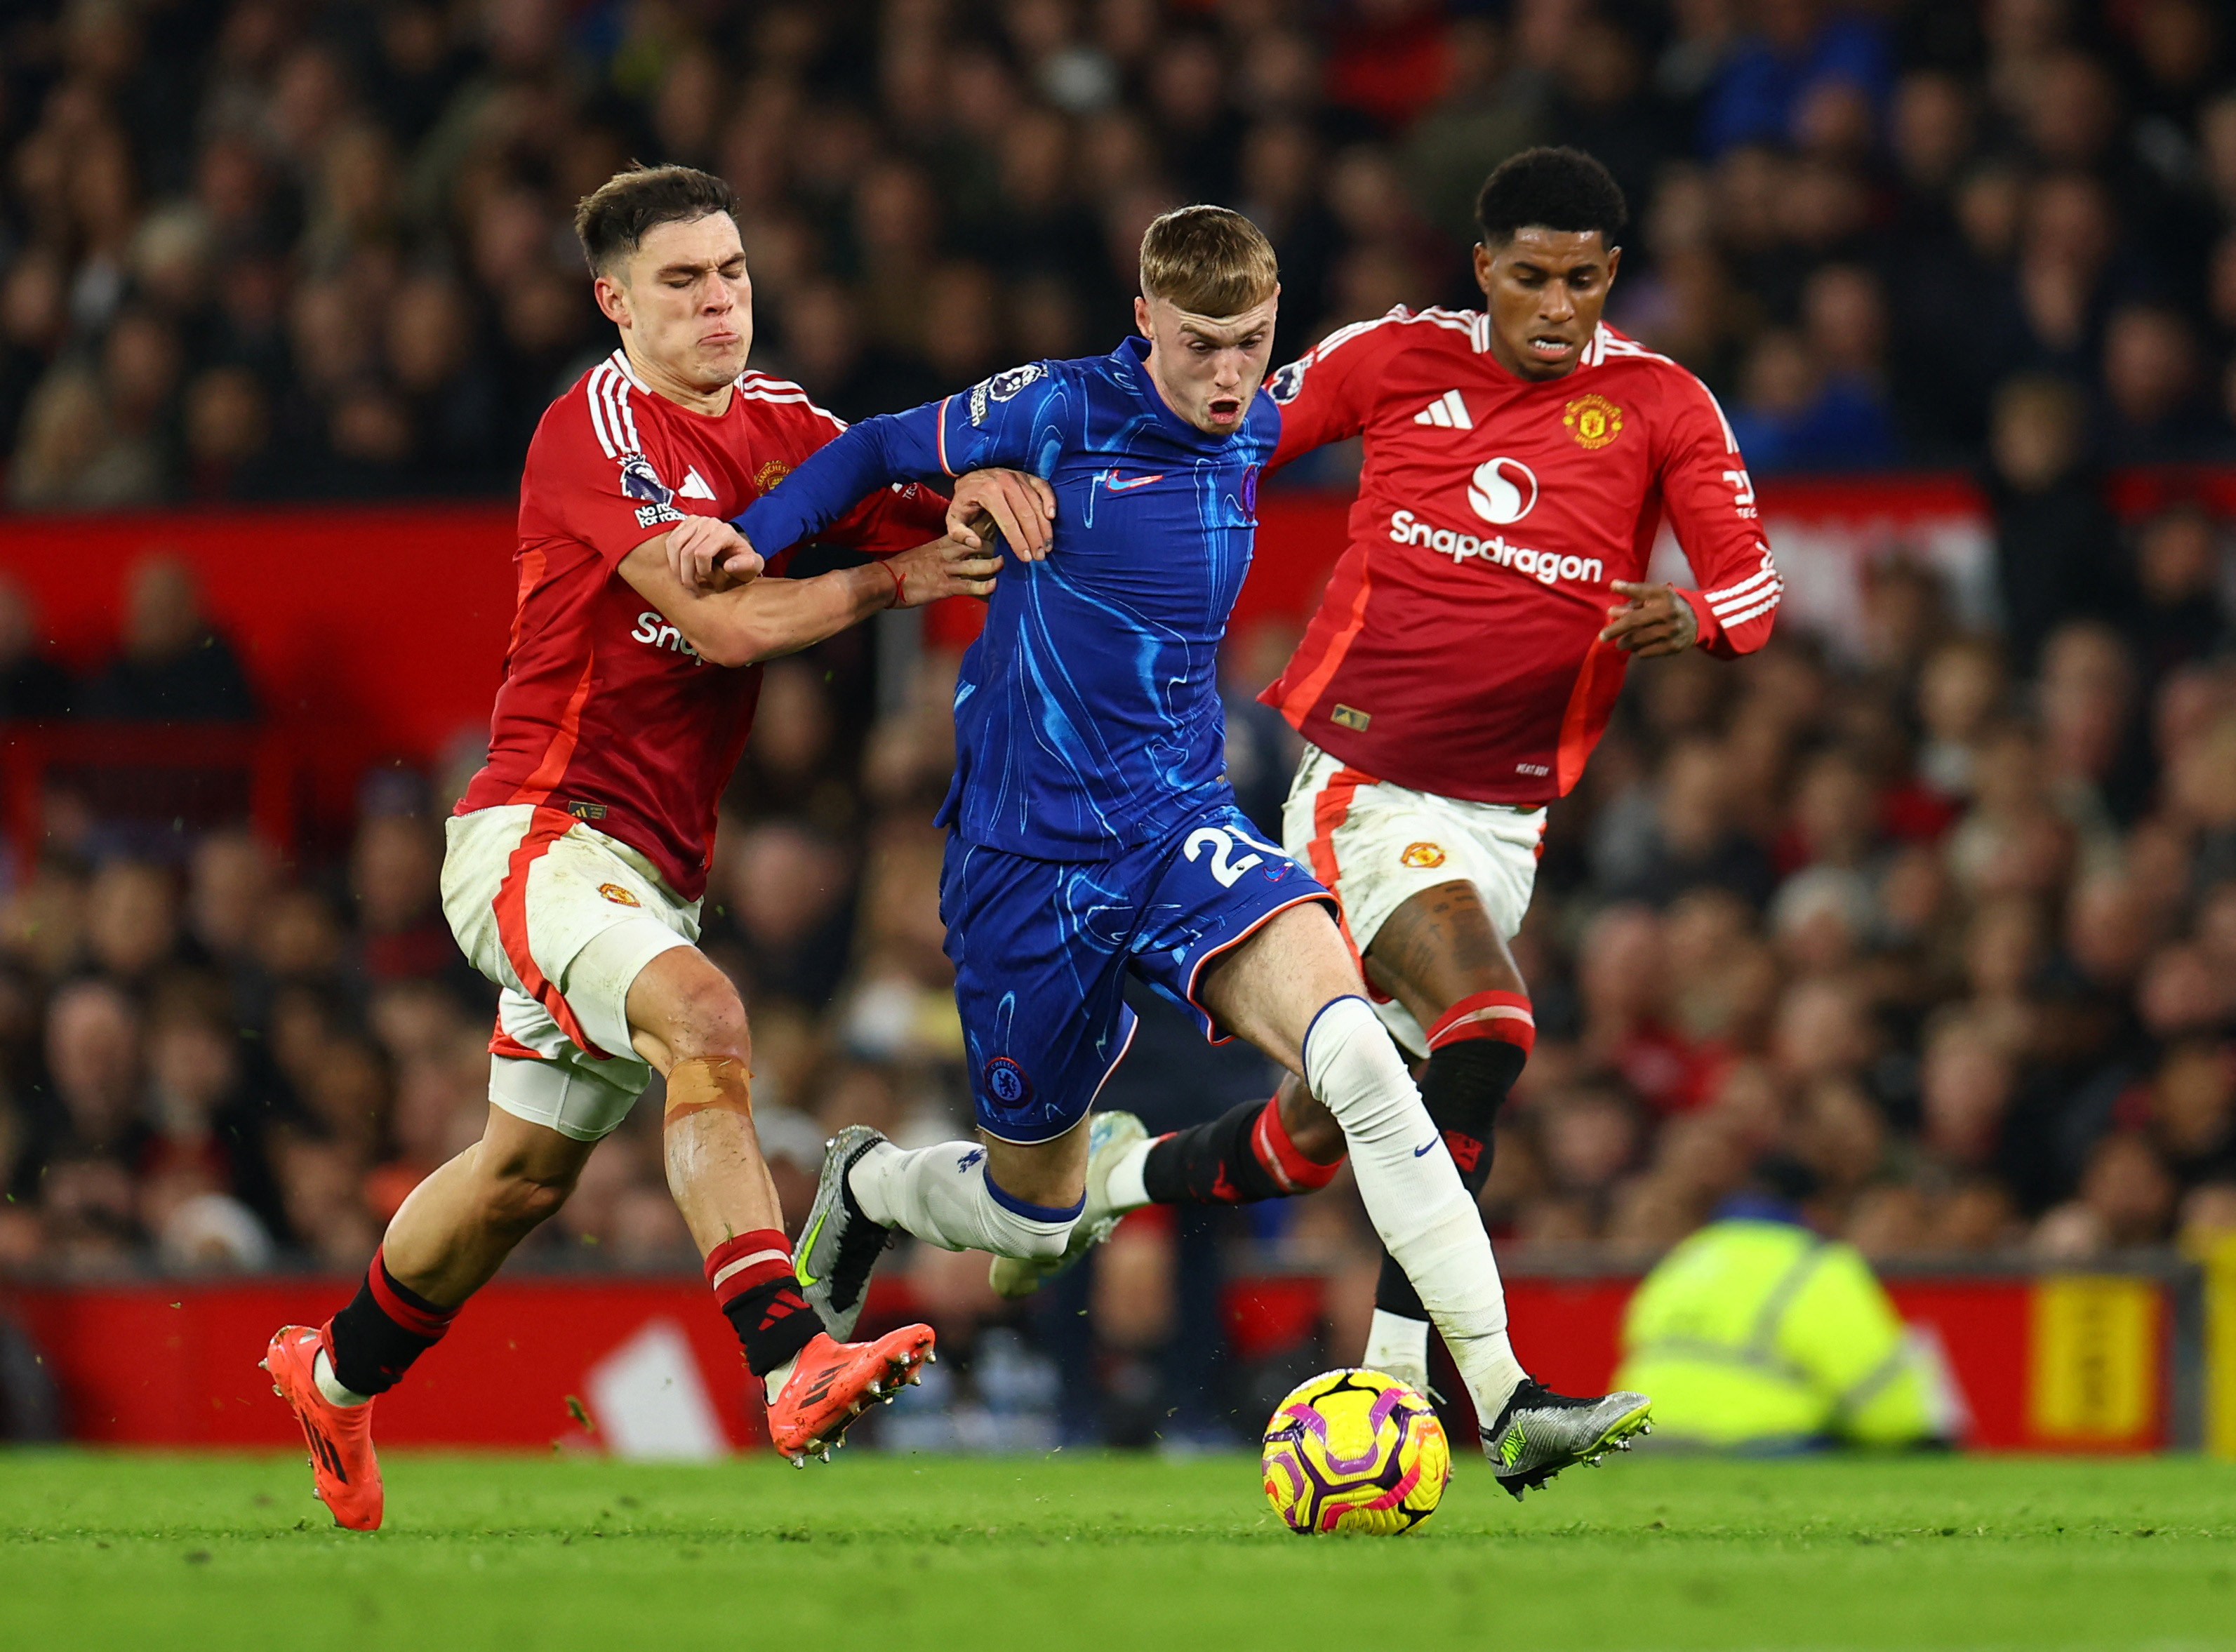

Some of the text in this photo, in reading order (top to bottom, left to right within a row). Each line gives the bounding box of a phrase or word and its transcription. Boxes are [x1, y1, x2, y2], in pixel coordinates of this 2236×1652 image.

[757, 465, 790, 487] MANCHEST
[902, 482, 917, 500] TEC
[634, 506, 656, 520] No
[1735, 507, 1758, 519] TEC
[1389, 510, 1603, 585] Snapdragon
